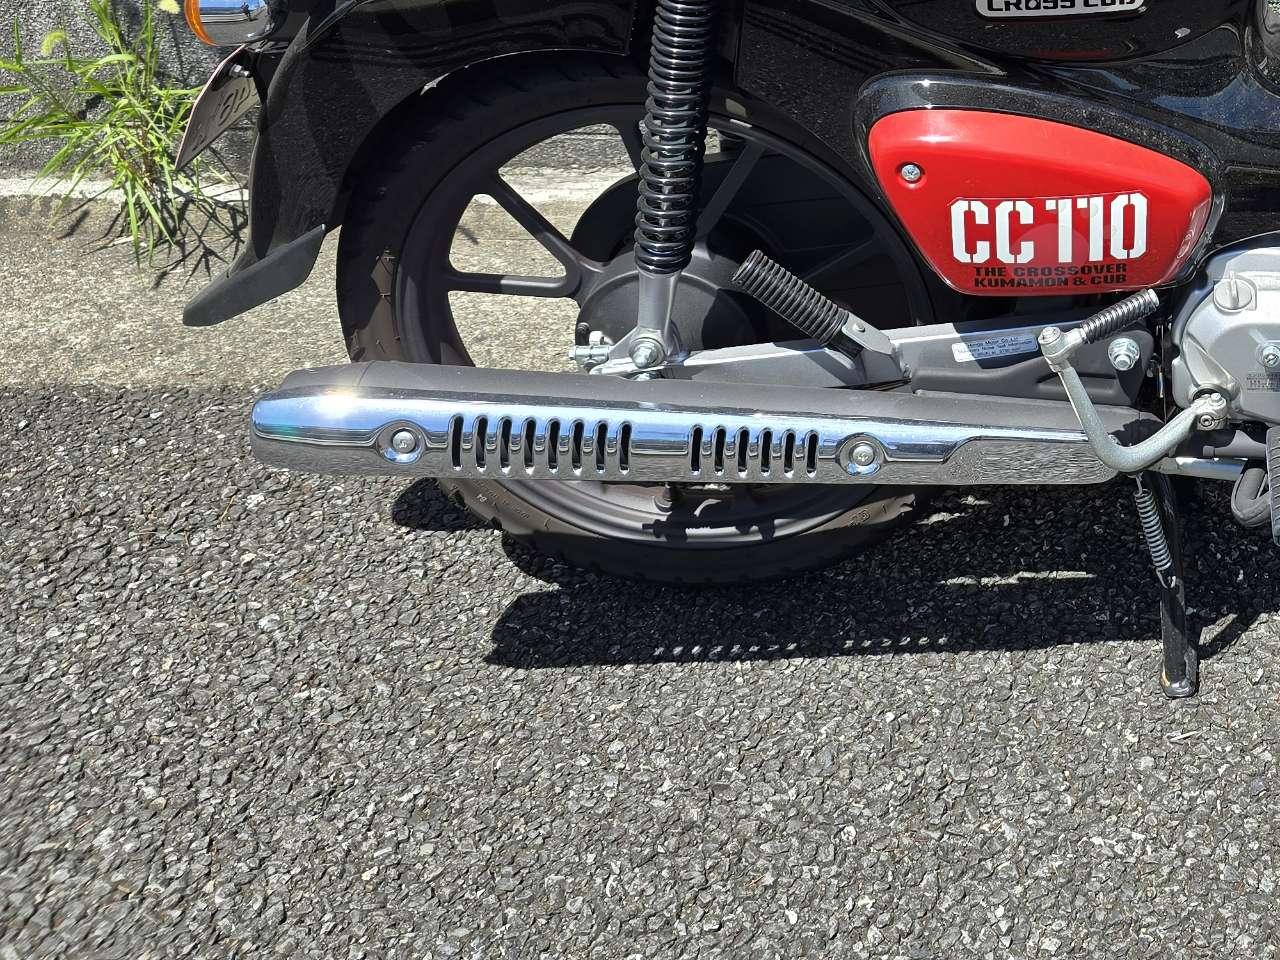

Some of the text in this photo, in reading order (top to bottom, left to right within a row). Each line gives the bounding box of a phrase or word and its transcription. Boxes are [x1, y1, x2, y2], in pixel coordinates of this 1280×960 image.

[950, 192, 1148, 264] CC110
[974, 262, 1128, 278] THE CROSSOVER
[973, 274, 1128, 289] KUMAMON & CUB
